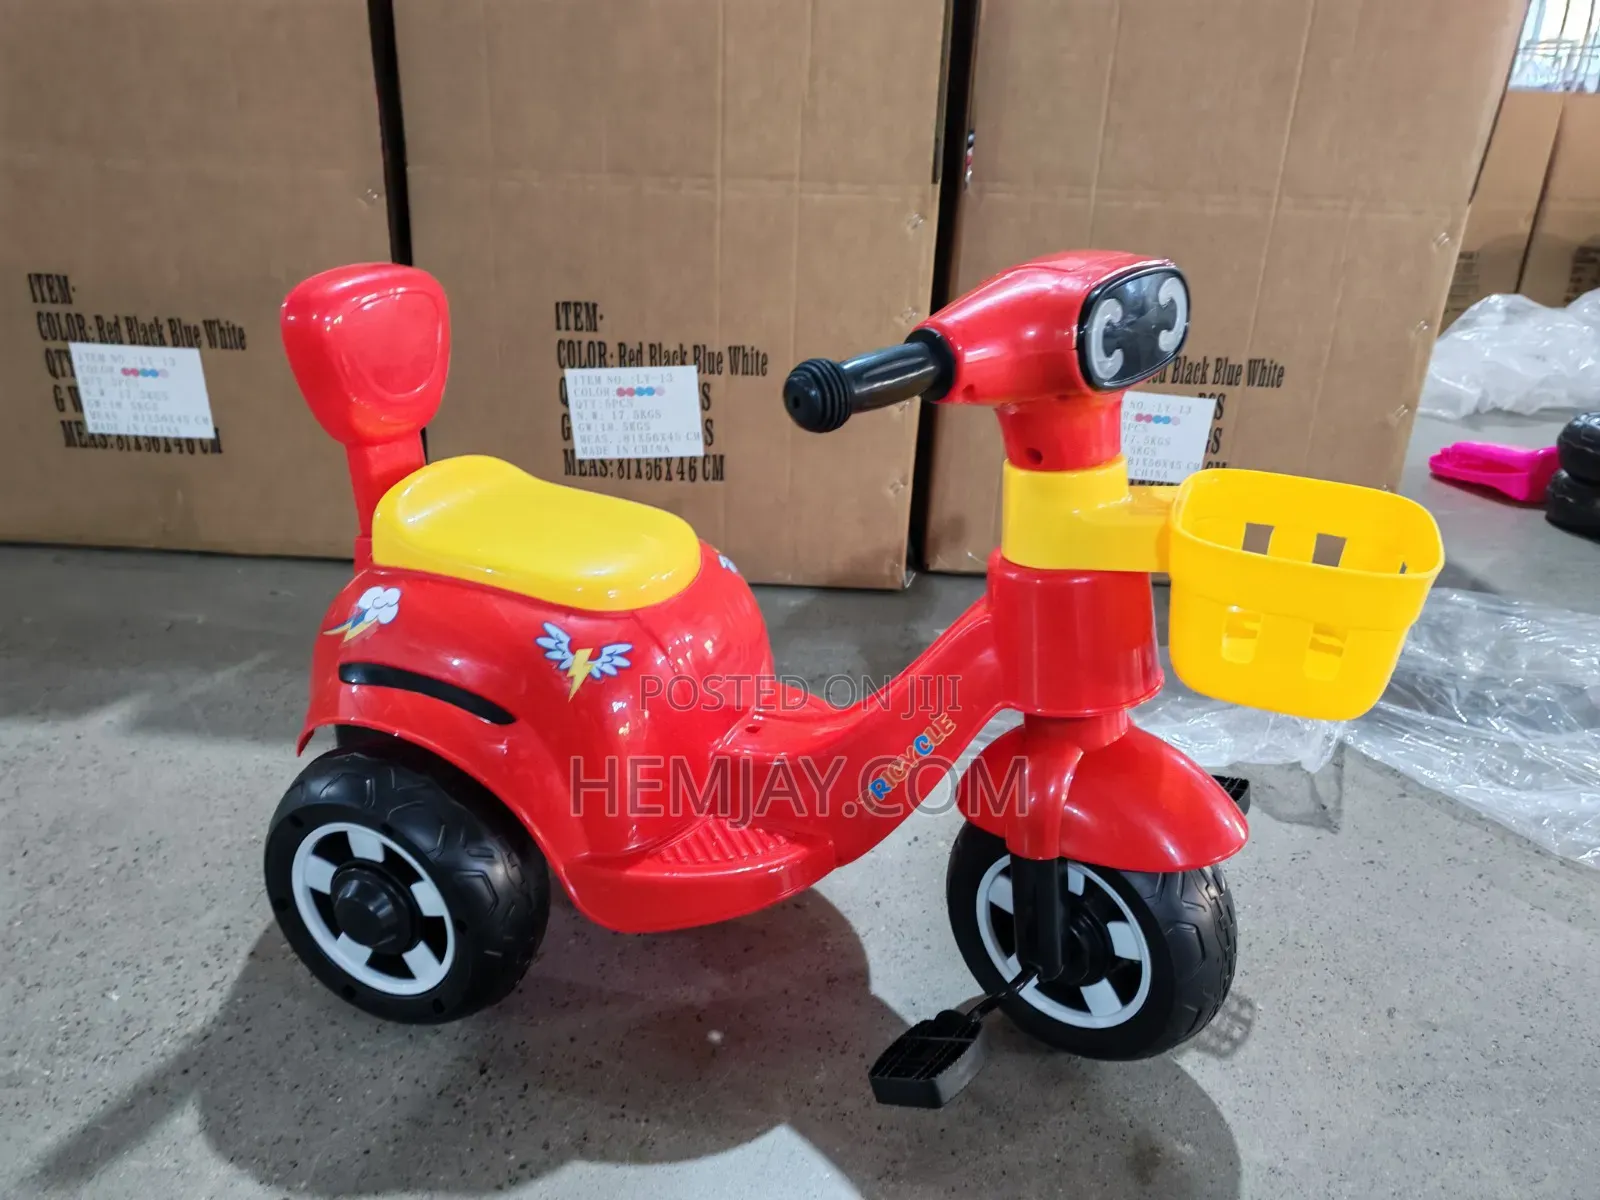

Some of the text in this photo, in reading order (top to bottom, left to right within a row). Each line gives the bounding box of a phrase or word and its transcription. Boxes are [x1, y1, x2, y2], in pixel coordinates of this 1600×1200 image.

[94, 314, 124, 344] Red
[124, 315, 166, 347] Black
[167, 318, 202, 348] Blue
[203, 319, 247, 350] White
[556, 338, 768, 377] COLOR: Red Black Blue White
[1170, 355, 1210, 386] Black
[1211, 357, 1243, 387] Blue
[1246, 357, 1285, 388] White
[573, 375, 602, 387] ITEM
[580, 444, 671, 456] MADE IN CHINA
[702, 454, 725, 482] CM
[1134, 468, 1168, 480] CHINA
[856, 712, 957, 811] TRICYCLE
